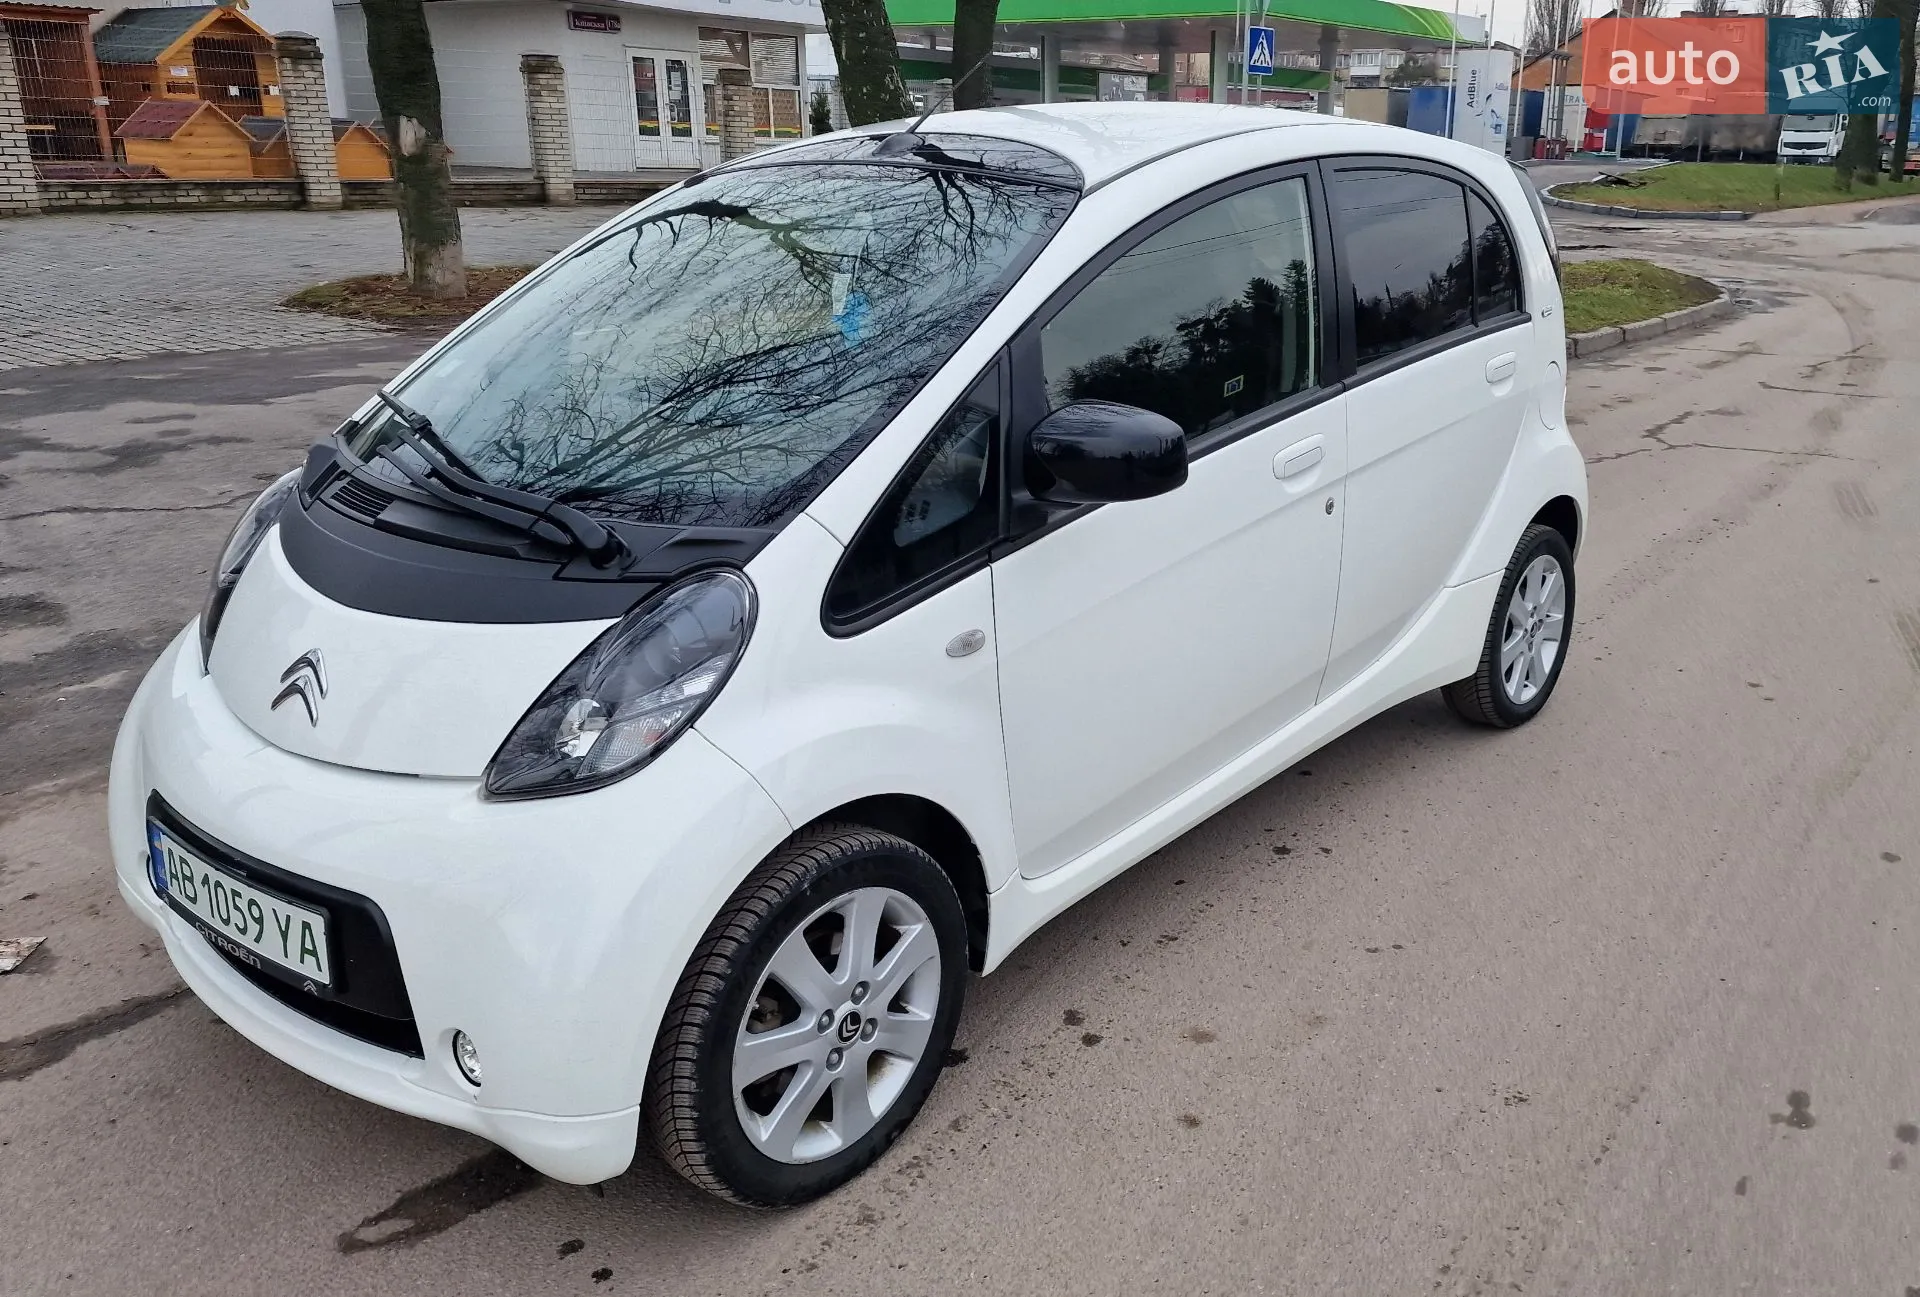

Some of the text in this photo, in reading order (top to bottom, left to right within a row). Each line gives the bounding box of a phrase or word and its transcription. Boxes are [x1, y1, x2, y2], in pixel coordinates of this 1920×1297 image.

[1466, 69, 1478, 109] AdBlue
[167, 847, 323, 973] AB 1059 YA
